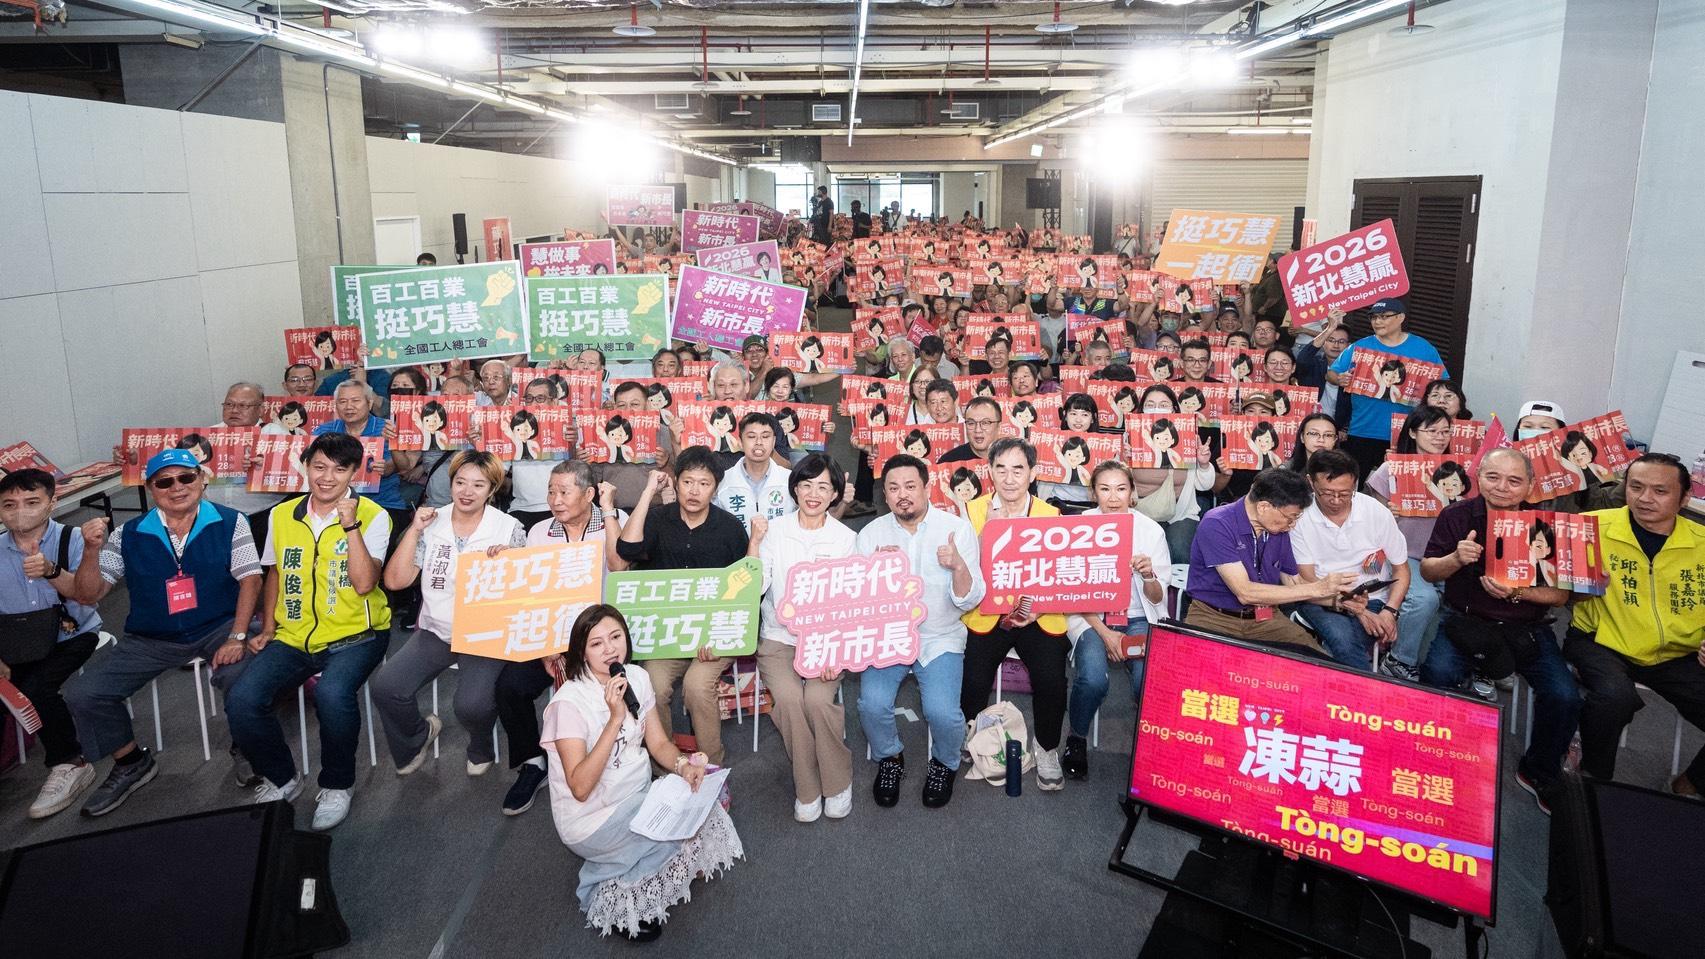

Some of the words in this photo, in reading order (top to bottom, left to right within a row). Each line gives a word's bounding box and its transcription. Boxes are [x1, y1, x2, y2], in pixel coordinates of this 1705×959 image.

[697, 214, 739, 229] 新時代
[1168, 215, 1277, 246] 挺巧慧
[698, 233, 737, 247] 新市長
[530, 246, 581, 265] 慧做事
[711, 246, 750, 263] 2026
[1304, 227, 1388, 275] 2026
[1166, 252, 1265, 282] 一起衝
[702, 275, 774, 306] 新時代
[1291, 252, 1399, 308] 新北慧贏
[370, 277, 467, 305] 百工百業
[537, 285, 620, 306] 百工百業
[1328, 299, 1347, 310] New
[1348, 289, 1377, 303] Taipei
[1378, 281, 1399, 294] City
[723, 301, 746, 310] TAIPEI
[748, 306, 766, 315] CITY
[374, 300, 484, 340] 挺巧慧
[538, 308, 632, 338] 挺巧慧
[700, 307, 766, 335] 新市長
[1010, 324, 1037, 336] 新市長
[404, 336, 489, 356] 全國工人總工會
[562, 341, 636, 353] 全國工人總工會
[821, 335, 851, 347] 新市長
[1352, 350, 1386, 367] 新時代
[1059, 369, 1090, 382] 新時代
[1404, 362, 1441, 380] 新市長
[667, 382, 705, 394] 新市長
[1087, 385, 1118, 397] 新時代
[1203, 386, 1237, 400] 新市長
[1287, 389, 1319, 403] 新市長
[444, 400, 477, 414] 新市長
[474, 409, 513, 424] 新時代
[534, 409, 569, 424] 新市長
[677, 403, 713, 418] 新時代
[797, 407, 830, 421] 新市長
[872, 430, 906, 445] 新時代
[926, 427, 961, 442] 新市長
[1220, 420, 1255, 434] 新時代
[1273, 420, 1301, 435] 新市
[1583, 414, 1629, 441] 新市長
[128, 433, 179, 449] 新時代
[207, 431, 254, 446] 新市長
[256, 440, 305, 455] 新時代
[1030, 431, 1065, 447] 新時代
[1087, 437, 1121, 453] 新市長
[1387, 459, 1436, 477] 新時代
[1401, 499, 1437, 512] 蘇巧慧
[1019, 522, 1121, 553] 2026
[430, 543, 452, 591] 黃淑君
[463, 543, 597, 605] 挺巧慧
[991, 554, 1121, 590] 新北慧贏
[282, 546, 303, 621] 陳俊諺
[615, 576, 721, 605] 百工百業
[791, 557, 903, 606] 新時代
[1679, 568, 1698, 612] 張嘉玲
[1031, 594, 1054, 603] New
[1055, 591, 1091, 602] Taipei
[1093, 591, 1118, 600] City
[795, 613, 825, 626] NEW
[831, 605, 875, 621] TAIPEI
[879, 601, 912, 614] CITY
[623, 610, 750, 656] 挺巧慧
[802, 620, 913, 670] 新市長
[1227, 671, 1300, 694] Tòng-suán
[1181, 687, 1241, 727] 當選
[1326, 703, 1452, 741] Tòng-suán
[1237, 725, 1365, 797] 凍蒜
[1413, 740, 1481, 764] Tòng-soán
[1150, 773, 1232, 805] Tòng-soán
[1226, 775, 1285, 797] Tòng-suán
[1391, 767, 1455, 807] 當選
[1312, 795, 1350, 819] 當選
[1359, 797, 1445, 828] Tòng-soán
[1275, 805, 1478, 877] Tòng-soán
